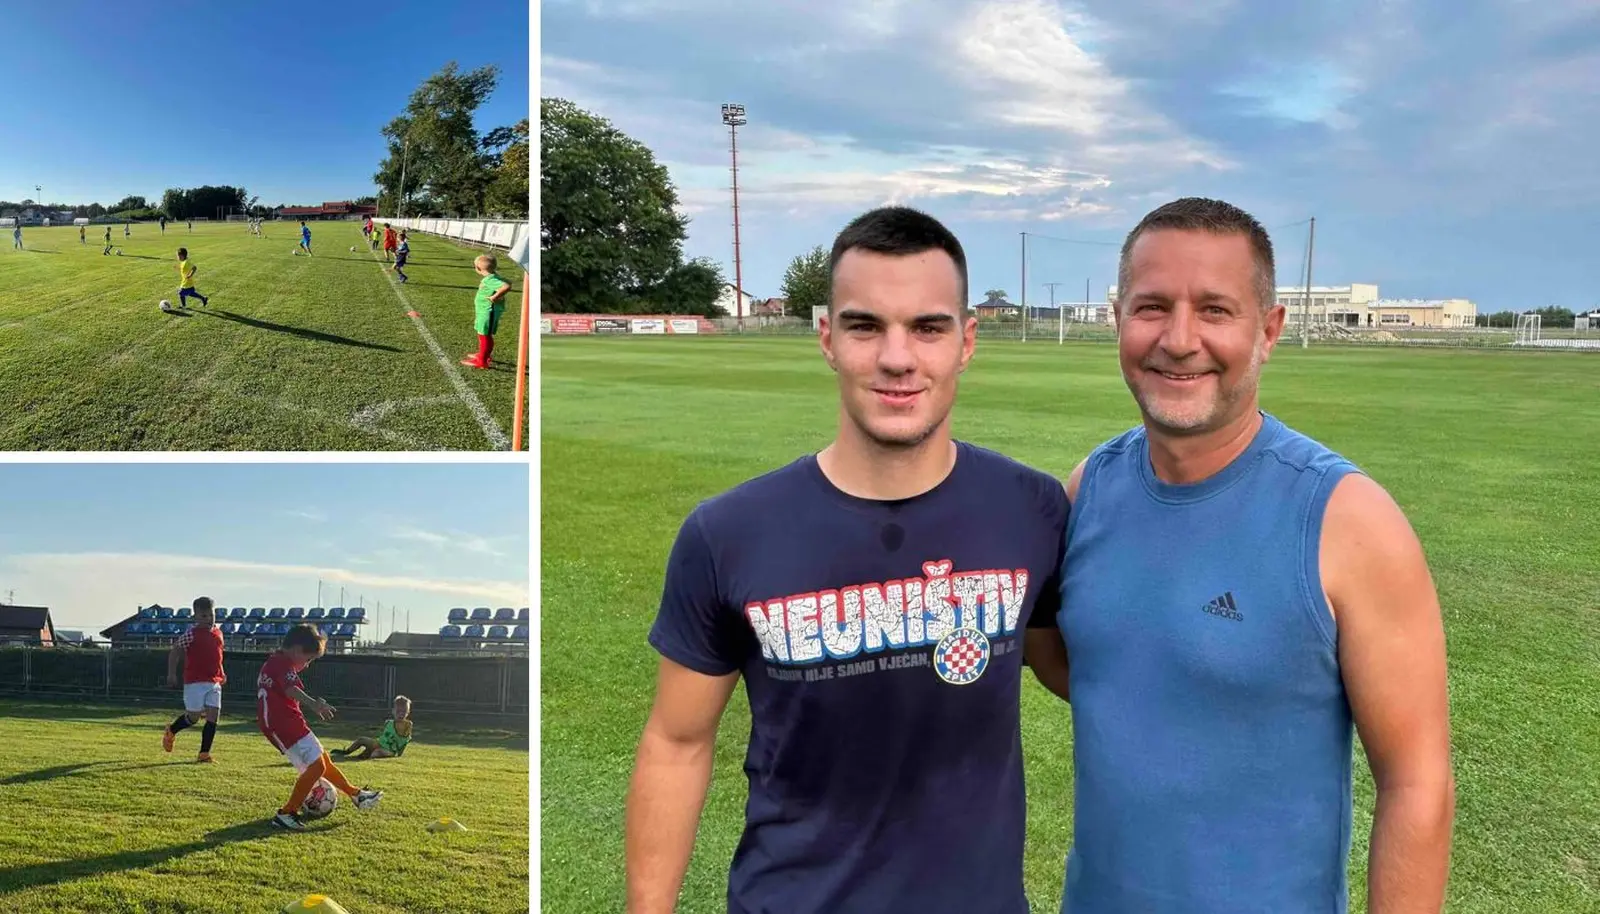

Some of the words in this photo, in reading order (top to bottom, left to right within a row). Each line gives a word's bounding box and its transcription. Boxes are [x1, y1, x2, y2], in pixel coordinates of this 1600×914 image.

[746, 560, 1028, 663] NEUNIŠTIV
[1202, 604, 1243, 622] adidas
[941, 631, 985, 650] HAJDUK
[805, 665, 834, 682] NIJE
[837, 660, 876, 678] SAMO
[944, 668, 979, 682] SPLIT
